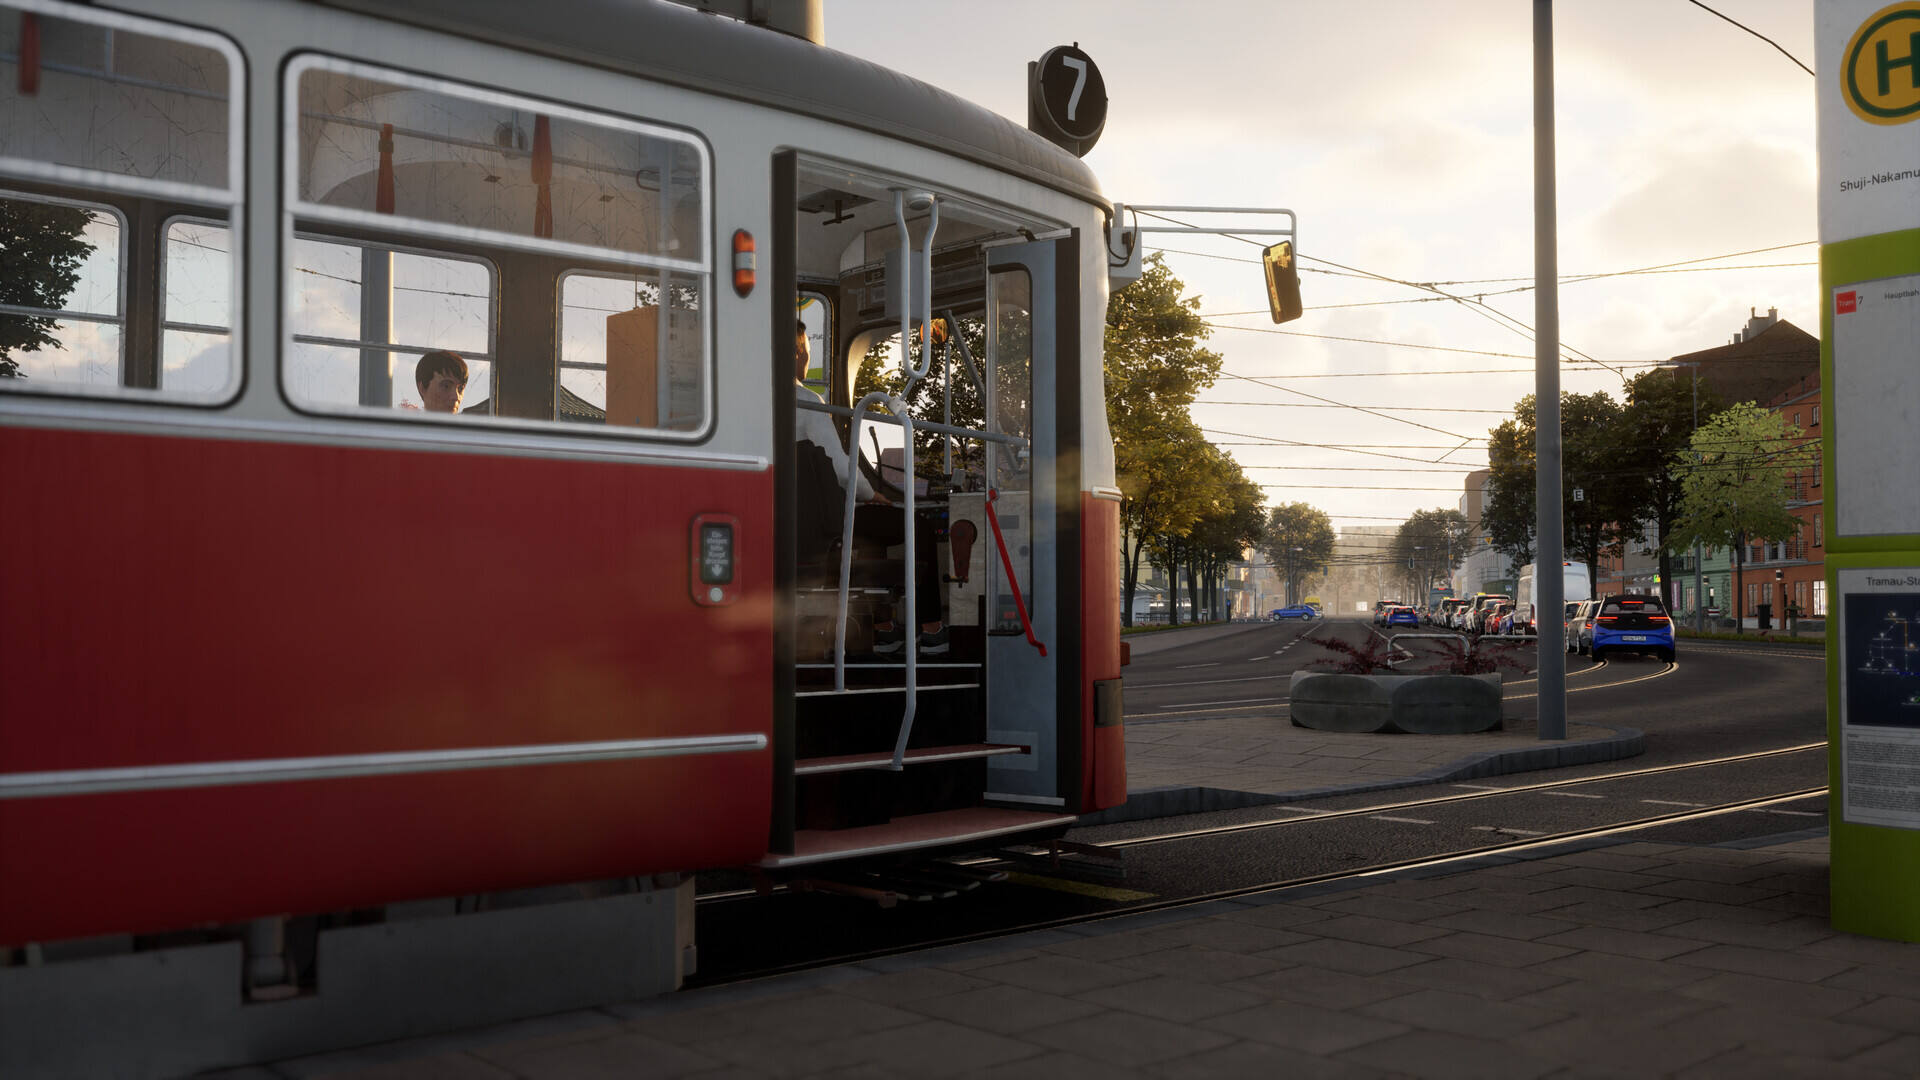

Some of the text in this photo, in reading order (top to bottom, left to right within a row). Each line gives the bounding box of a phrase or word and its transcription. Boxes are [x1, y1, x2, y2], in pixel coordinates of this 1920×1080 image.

[1063, 55, 1087, 121] 7
[1875, 31, 1920, 97] H
[1857, 296, 1864, 304] 7
